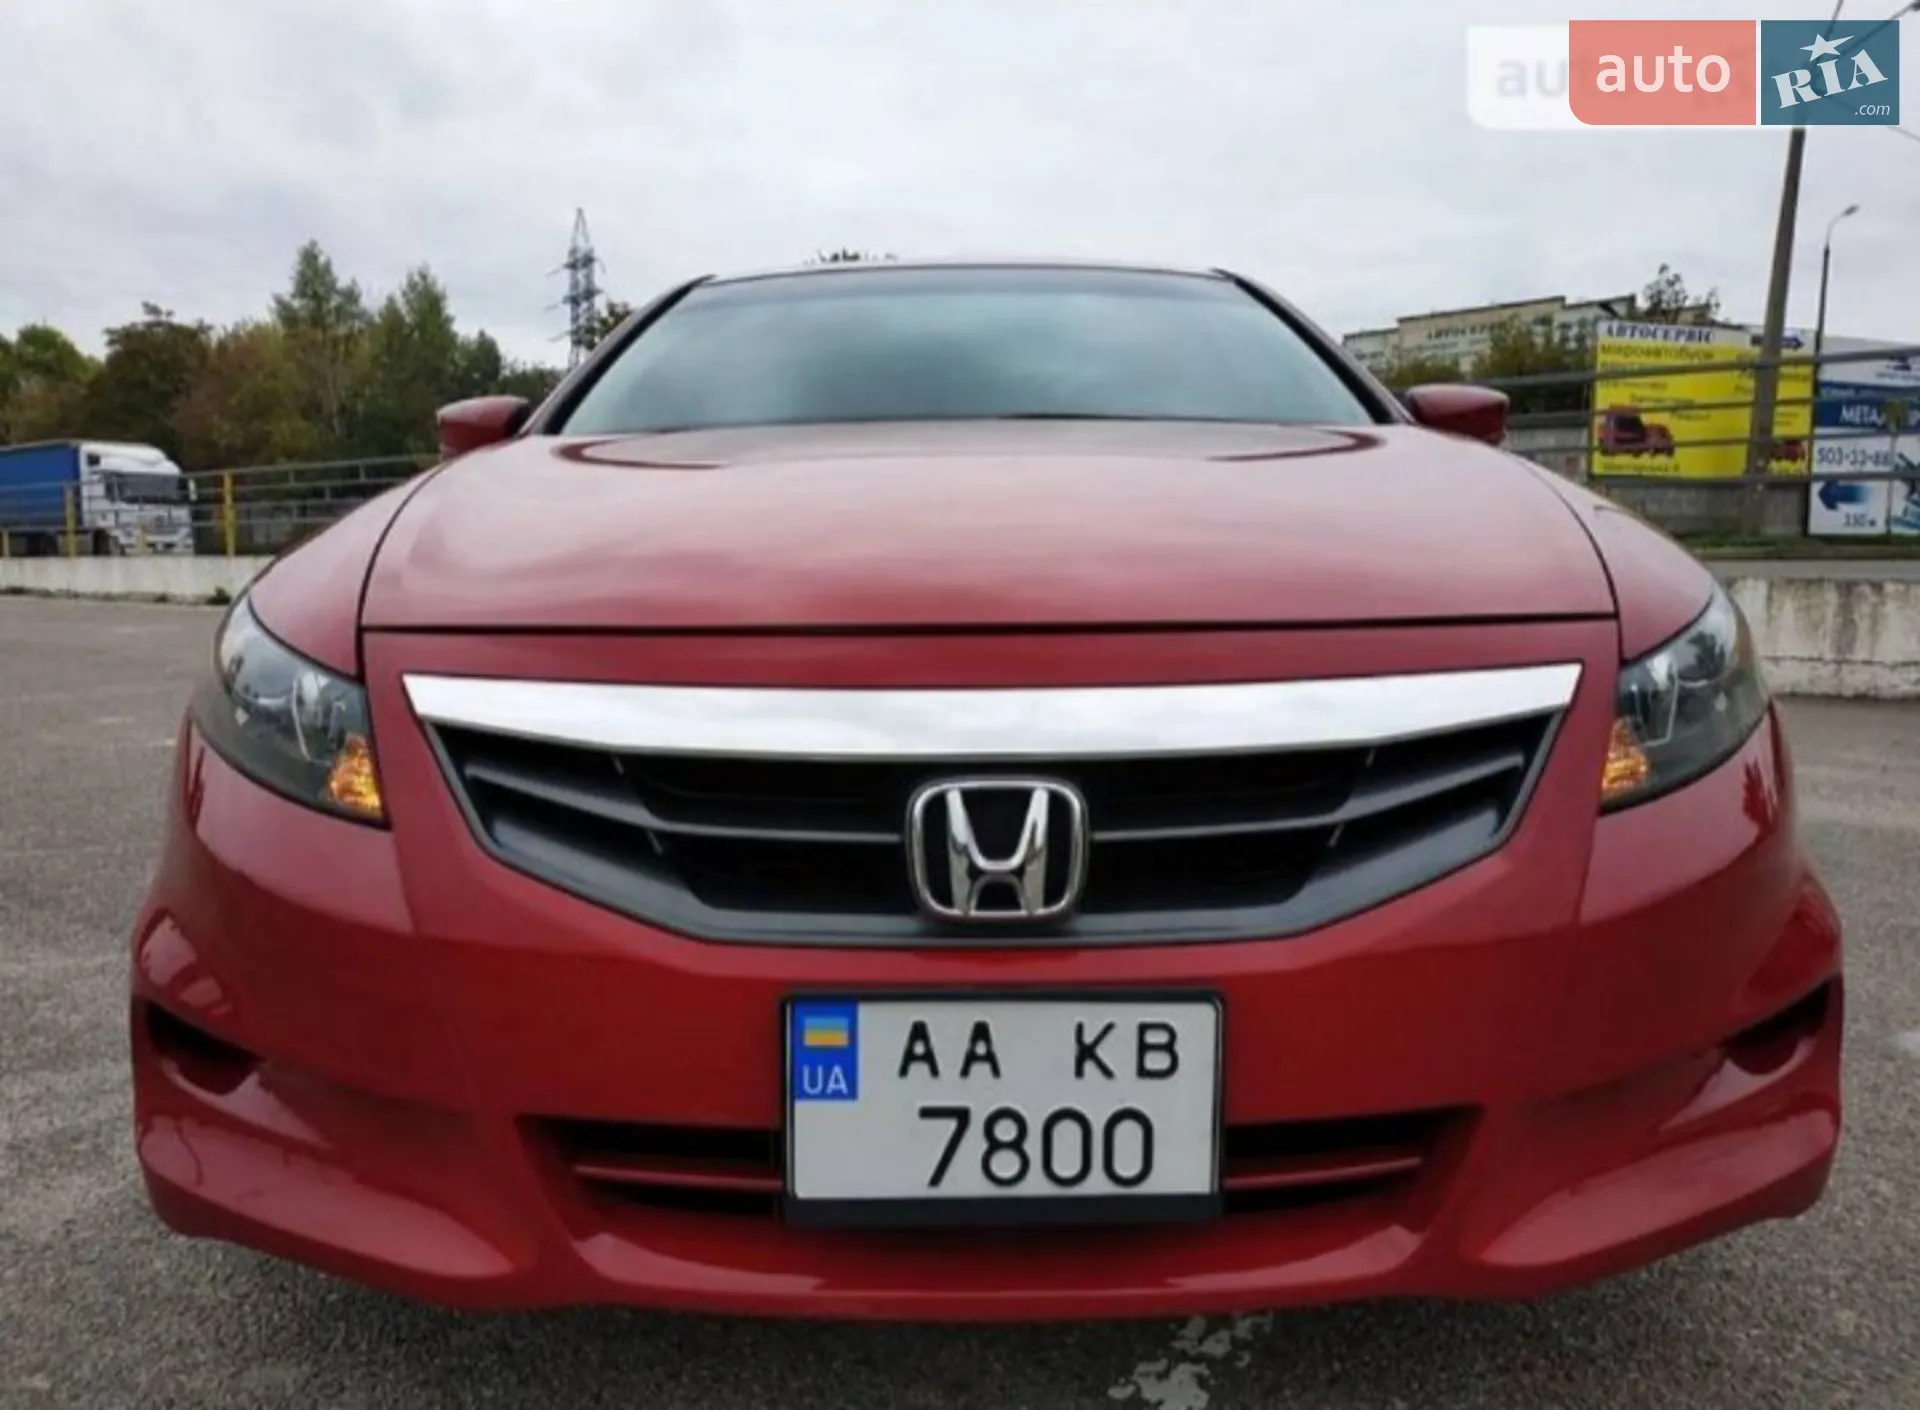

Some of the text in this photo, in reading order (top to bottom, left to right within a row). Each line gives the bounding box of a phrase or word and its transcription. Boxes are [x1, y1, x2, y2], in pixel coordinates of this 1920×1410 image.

[801, 1064, 849, 1094] UA
[897, 1019, 1180, 1080] AA KB
[917, 1106, 1155, 1189] 7800
